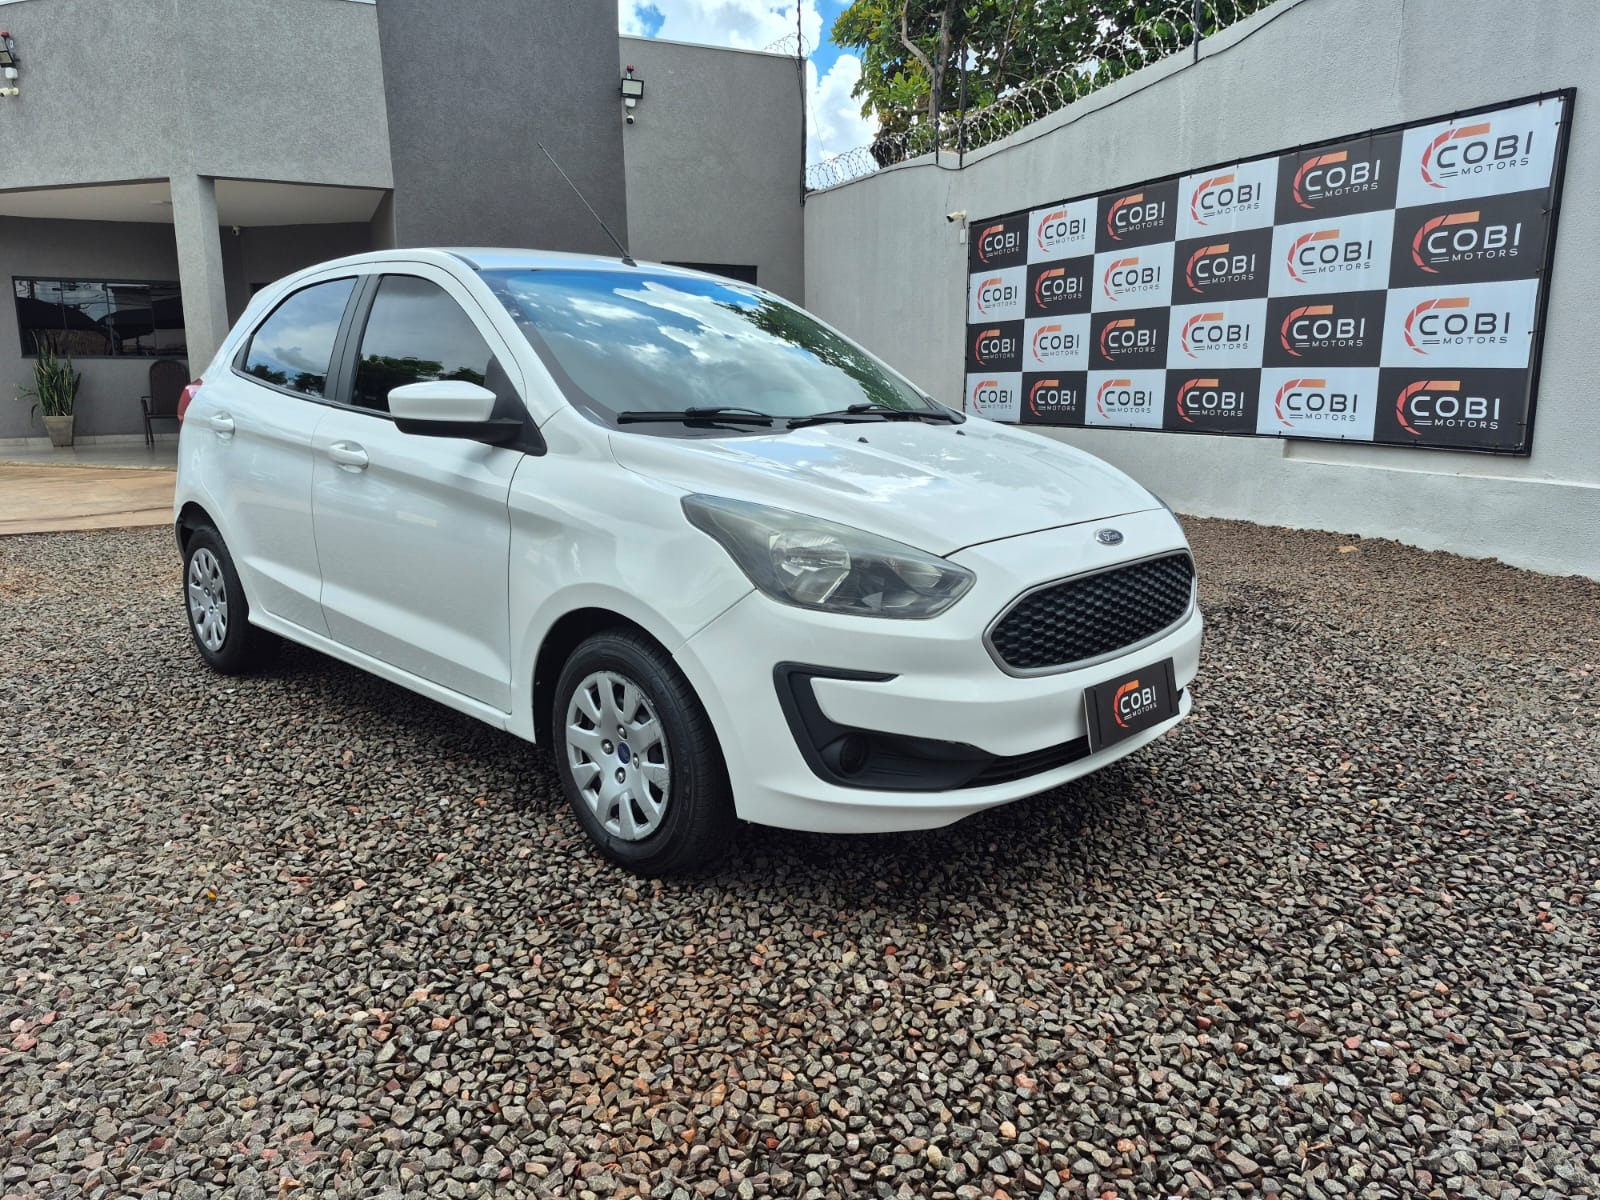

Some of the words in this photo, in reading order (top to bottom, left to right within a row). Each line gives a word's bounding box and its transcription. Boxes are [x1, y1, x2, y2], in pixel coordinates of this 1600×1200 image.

[1436, 131, 1533, 168] COBI
[1305, 159, 1380, 188] COBI
[1461, 158, 1528, 176] MOTORS
[1201, 182, 1260, 210] COBI
[1325, 182, 1377, 197] MOTORS
[1116, 201, 1165, 226] COBI
[1217, 202, 1260, 215] MOTORS
[1044, 217, 1085, 239] COBI
[1129, 220, 1165, 232] MOTORS
[984, 232, 1019, 250] COBI
[1054, 234, 1085, 245] MOTORS
[1427, 223, 1522, 254] COBI
[1299, 240, 1372, 266] COBI
[1452, 248, 1518, 262] MOTORS
[1196, 254, 1256, 278] COBI
[1319, 262, 1370, 273] MOTORS
[1112, 266, 1160, 287] COBI
[1212, 274, 1254, 284] MOTORS
[983, 286, 1017, 302] COBI
[1042, 277, 1082, 295] COBI
[1125, 284, 1159, 293] MOTORS
[1053, 293, 1082, 302] MOTORS
[1292, 318, 1365, 339] COBI
[1419, 312, 1510, 335] COBI
[1108, 329, 1156, 347] COBI
[1192, 324, 1249, 343] COBI
[1443, 336, 1508, 345] MOTORS
[981, 338, 1015, 353] COBI
[1039, 334, 1079, 350] COBI
[1122, 346, 1155, 354] MOTORS
[1312, 339, 1363, 347] MOTORS
[979, 390, 1012, 403] COBI
[1036, 390, 1076, 404] COBI
[1105, 390, 1151, 406] COBI
[1186, 391, 1244, 408] COBI
[1286, 393, 1357, 413] COBI
[1410, 397, 1499, 420] COBI
[1305, 413, 1356, 422] MOTORS
[1434, 419, 1498, 429] MOTORS
[1120, 686, 1156, 714] COBI
[1133, 703, 1157, 716] MOTORS
